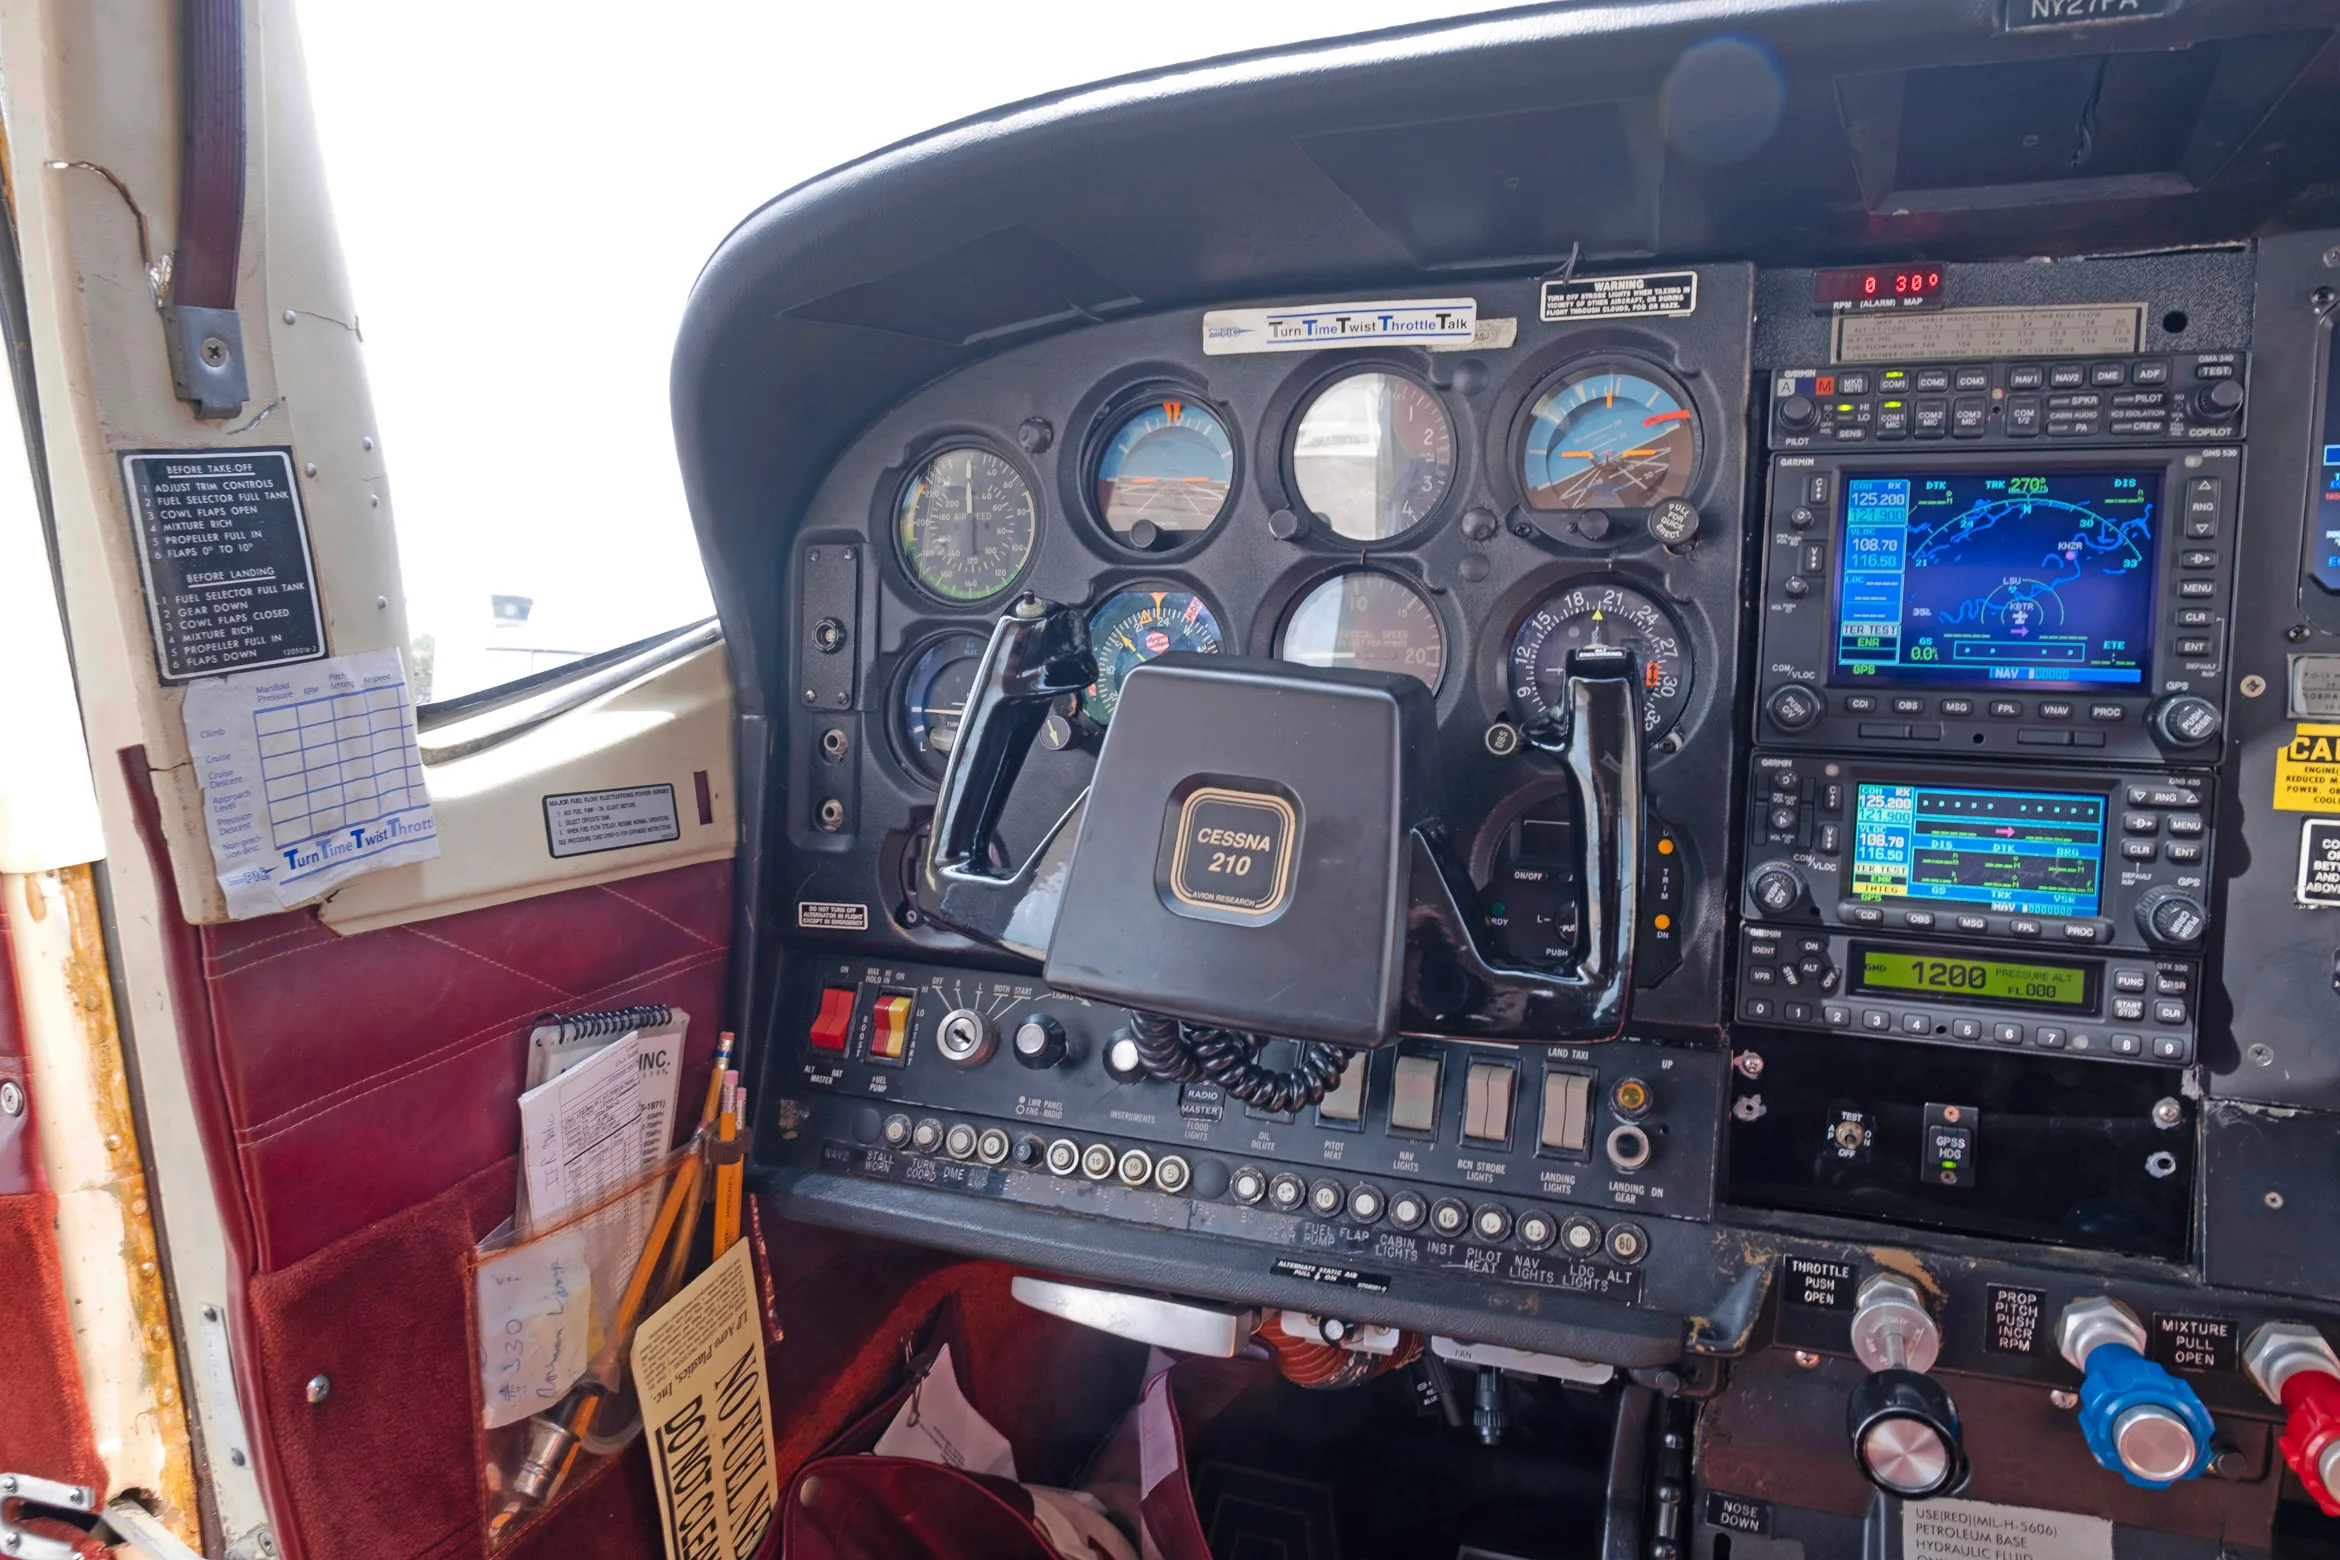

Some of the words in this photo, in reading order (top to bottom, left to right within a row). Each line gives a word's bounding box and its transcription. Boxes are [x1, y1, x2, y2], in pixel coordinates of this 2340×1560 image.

[1594, 280, 1645, 292] WARNING
[1833, 301, 1852, 310] RPM
[1860, 298, 1896, 308] (ALARM)
[1904, 298, 1923, 306] MAP
[1268, 322, 1302, 338] Turn
[1302, 320, 1338, 336] Time
[1336, 317, 1376, 334] Twist
[1377, 315, 1436, 332] Throttle
[1436, 313, 1468, 330] Talk
[2055, 372, 2080, 382] NAV2
[2098, 370, 2119, 380] DME
[2140, 368, 2161, 379] ADF
[2203, 366, 2229, 376] TEST
[1920, 378, 1945, 387] COM2
[2135, 394, 2163, 403] PILOT
[2133, 422, 2162, 431] CREW
[2189, 427, 2233, 438] COPILOT
[1786, 437, 1810, 446] PILOT
[167, 465, 202, 475] BEFORE
[208, 463, 254, 473] TAKE-OFF
[1780, 457, 1814, 467] GARMIN
[155, 483, 191, 493] ADJUST
[197, 482, 218, 491] TRIM
[223, 480, 274, 490] CONTROLS
[1926, 480, 1948, 490] DTK
[1985, 480, 2006, 490] TRK
[2114, 478, 2136, 488] DIS
[158, 496, 181, 506] FUEL
[187, 494, 234, 504] SELECTOR
[239, 492, 261, 502] FULL
[264, 491, 290, 500] TANK
[1851, 492, 1906, 507] 125.200
[161, 509, 192, 520] COWL
[197, 508, 226, 517] FLAPS
[231, 506, 258, 515] OPEN
[1668, 503, 1690, 517] PULL
[164, 521, 204, 532] MIXTURE
[210, 520, 233, 529] RICH
[1660, 518, 1684, 532] QUICK
[165, 532, 220, 545] PROPELLER
[224, 531, 246, 541] FULL
[251, 530, 262, 539] IN
[1852, 538, 1898, 552] 108.70
[1851, 554, 1897, 568] 116.50
[186, 572, 224, 583] BEFORE
[230, 567, 276, 579] LANDING
[2183, 584, 2212, 594] MENU
[1564, 591, 1586, 608] 18
[1604, 589, 1624, 606] 21
[178, 606, 208, 618] GEAR
[214, 602, 248, 613] DOWN
[1637, 604, 1660, 625] 24
[2186, 612, 2206, 622] CLR
[180, 618, 212, 630] COWL
[218, 614, 248, 625] FLAPS
[253, 608, 290, 621] CLOSED
[1857, 637, 1880, 648] ENR
[2184, 642, 2204, 652] ENT
[186, 656, 218, 667] FLAPS
[223, 650, 258, 662] DOWN
[1515, 645, 1532, 665] 12
[363, 673, 392, 686] Airspeed
[256, 682, 290, 694] Manifold
[303, 686, 320, 696] RPM
[257, 690, 294, 702] Pressure
[1946, 702, 1968, 712] MSG
[2044, 706, 2069, 716] VNAV
[2094, 706, 2121, 718] PROC
[200, 728, 226, 739] Climb
[206, 753, 231, 764] Cruise
[208, 768, 234, 780] Cruise
[2286, 774, 2326, 784] REDUCED
[210, 776, 244, 790] Descent
[212, 790, 251, 806] Approach
[1858, 795, 1912, 810] 125.200
[2155, 792, 2177, 803] RNG
[214, 802, 236, 814] Level
[2173, 820, 2201, 831] MENU
[1197, 828, 1270, 852] CESSNA
[283, 848, 320, 870] Turn
[316, 838, 353, 860] Time
[350, 828, 388, 849] Twist
[1858, 847, 1904, 862] 116.50
[2130, 845, 2150, 854] CLR
[1208, 852, 1252, 876] 210
[1192, 890, 1215, 902] AVION
[1216, 894, 1256, 906] RESEARCH
[2018, 922, 2035, 933] FPL
[2068, 926, 2094, 938] PROC
[1752, 946, 1776, 956] IDENT
[1754, 971, 1771, 981] VFR
[1911, 961, 1988, 989] 1200
[1995, 969, 2049, 982] PRESSURE
[2053, 972, 2074, 984] ALT
[2118, 976, 2144, 988] FUNC
[994, 984, 1011, 994] BOTH
[1548, 1048, 1570, 1059] LAND
[1572, 1050, 1589, 1061] TAXI
[1662, 1060, 1674, 1070] UP
[1188, 1089, 1218, 1101] RADIO
[1182, 1104, 1218, 1116] MASTER
[1840, 1110, 1864, 1122] TEST
[1324, 1140, 1344, 1151] PITOT
[1936, 1135, 1966, 1149] GPSS
[1324, 1150, 1343, 1161] HEAT
[1938, 1148, 1962, 1160] HDG
[943, 1166, 964, 1181] DME
[1457, 1160, 1476, 1171] BCN
[1477, 1162, 1506, 1174] STROBE
[1467, 1171, 1494, 1184] LIGHTS
[1541, 1172, 1576, 1186] LANDING
[1544, 1182, 1572, 1195] LIGHTS
[1609, 1182, 1645, 1196] LANDING
[1652, 1187, 1664, 1198] DN
[1615, 1192, 1637, 1204] GEAR
[1339, 1228, 1370, 1242] FLAP
[1380, 1234, 1416, 1250] CABIN
[1375, 1244, 1418, 1262] LIGHTS
[1427, 1240, 1456, 1257] INST
[1467, 1248, 1502, 1264] PILOT
[1515, 1255, 1540, 1270] NAV
[1792, 1260, 1850, 1278] THROTTLE
[1608, 1269, 1632, 1285] ALT
[1805, 1277, 1836, 1291] PUSH
[1804, 1290, 1834, 1305] OPEN
[1998, 1290, 2037, 1304] PROP
[1995, 1301, 2038, 1318] PITCH
[1996, 1313, 2036, 1330] PUSH
[2162, 1319, 2228, 1337] MIXTURE
[714, 1329, 736, 1349] Aero
[1998, 1326, 2033, 1340] INCR
[1999, 1336, 2030, 1352] RPM
[2176, 1336, 2214, 1351] PULL
[2175, 1350, 2215, 1366] OPEN
[715, 1341, 760, 1422] NO
[664, 1393, 707, 1454] DO
[722, 1396, 767, 1517] FUEL
[671, 1434, 715, 1509] NOT
[1724, 1500, 1759, 1518] NOSE
[1720, 1512, 1760, 1532] DOWN
[1916, 1522, 1992, 1543] PETROLEUM
[1996, 1533, 2028, 1549] BASE
